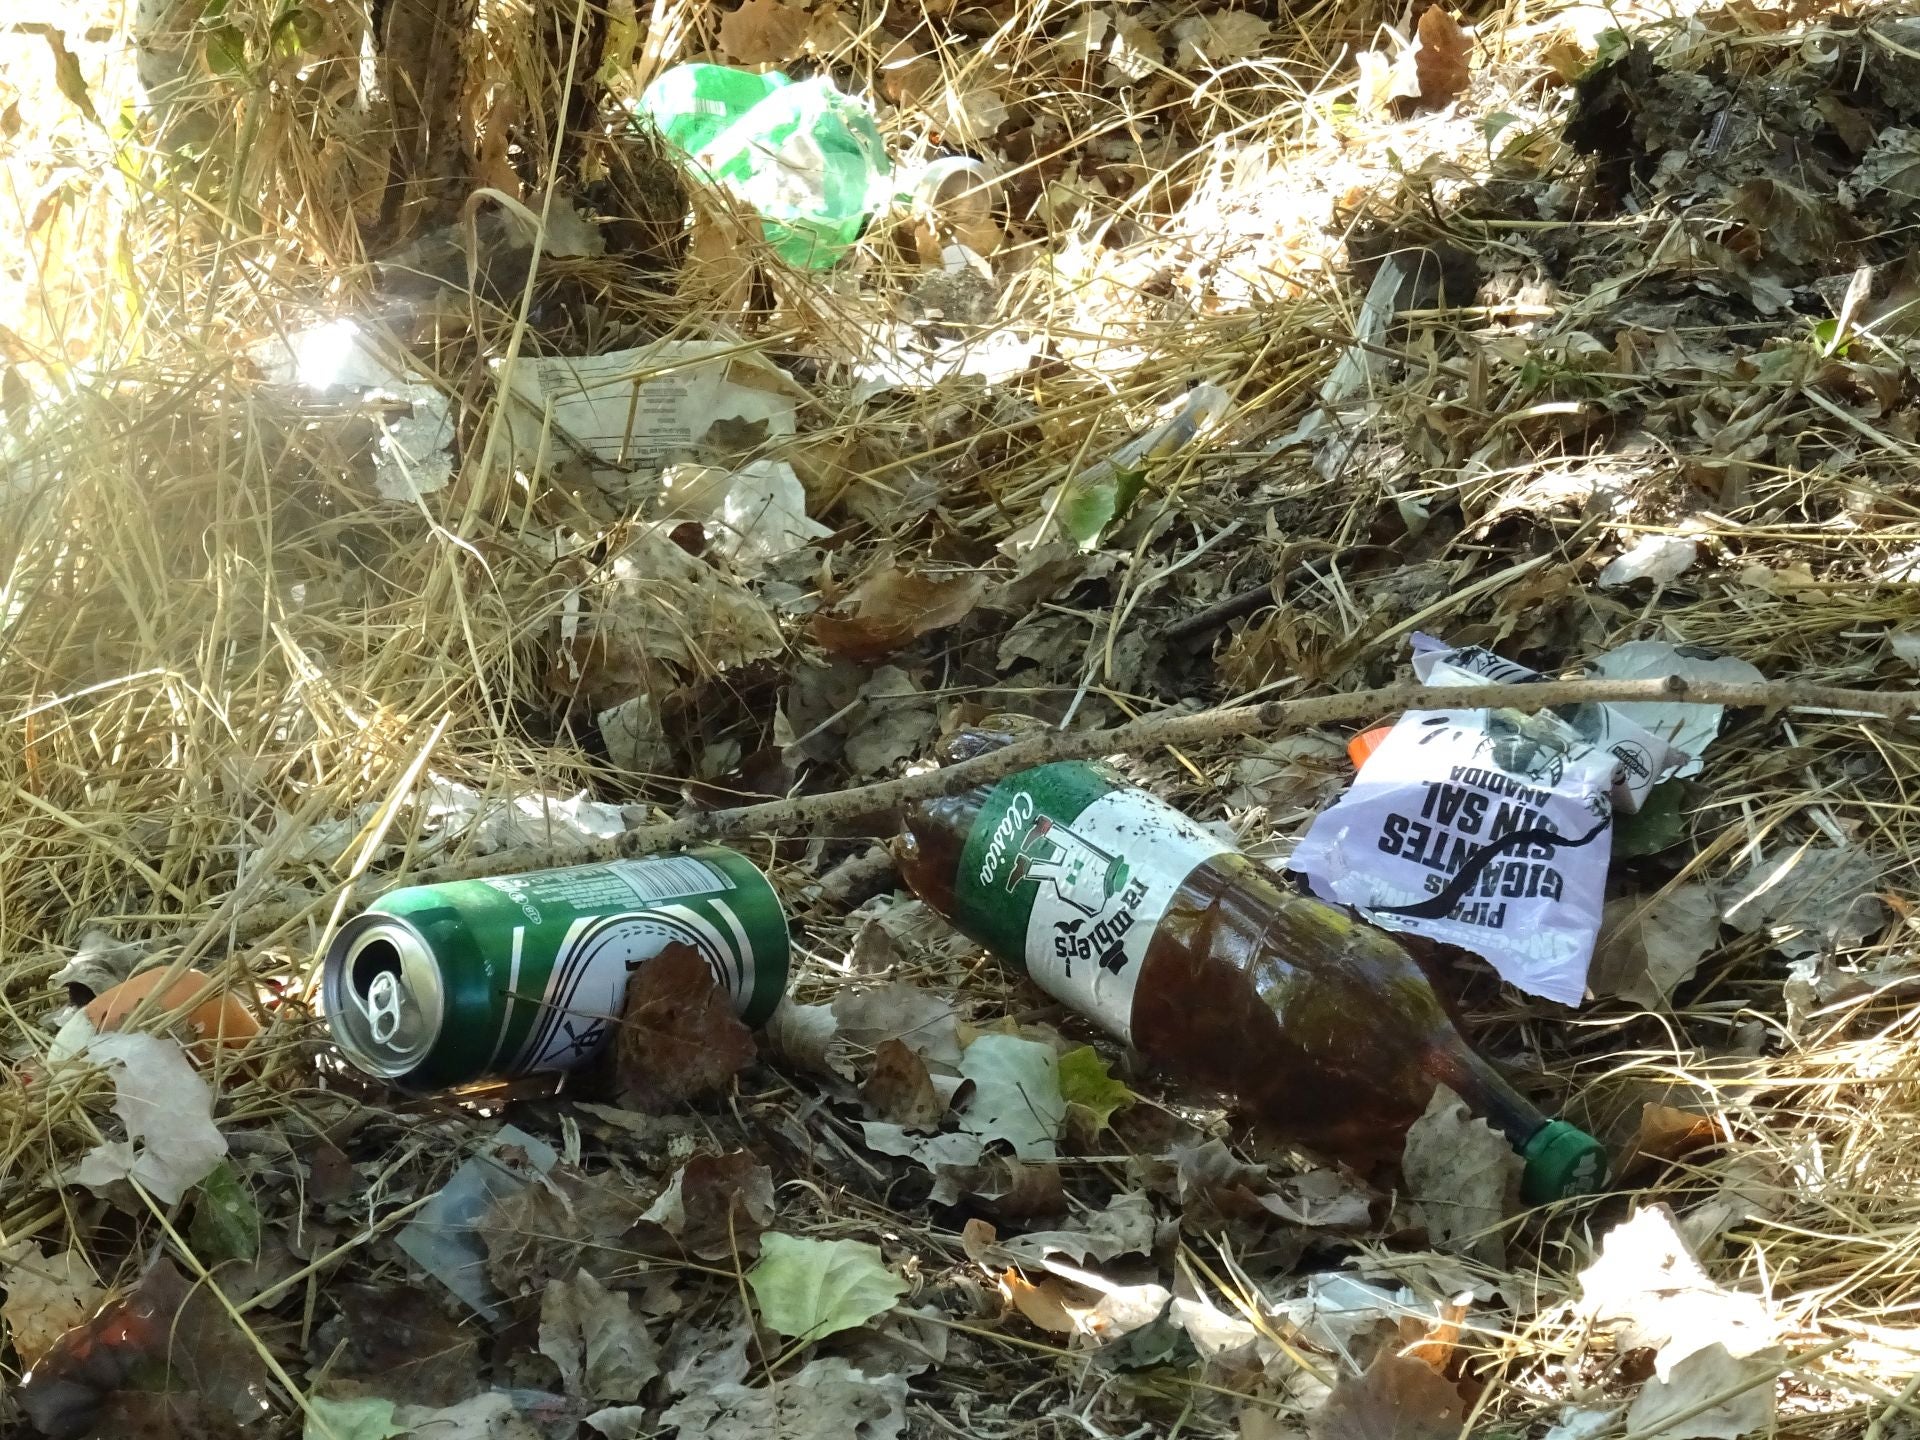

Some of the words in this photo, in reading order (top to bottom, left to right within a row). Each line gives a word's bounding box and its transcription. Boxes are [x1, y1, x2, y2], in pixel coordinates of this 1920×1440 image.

[1420, 780, 1489, 836] SAL
[1449, 765, 1552, 808] AÑADIDA
[979, 791, 1033, 886] Clásica
